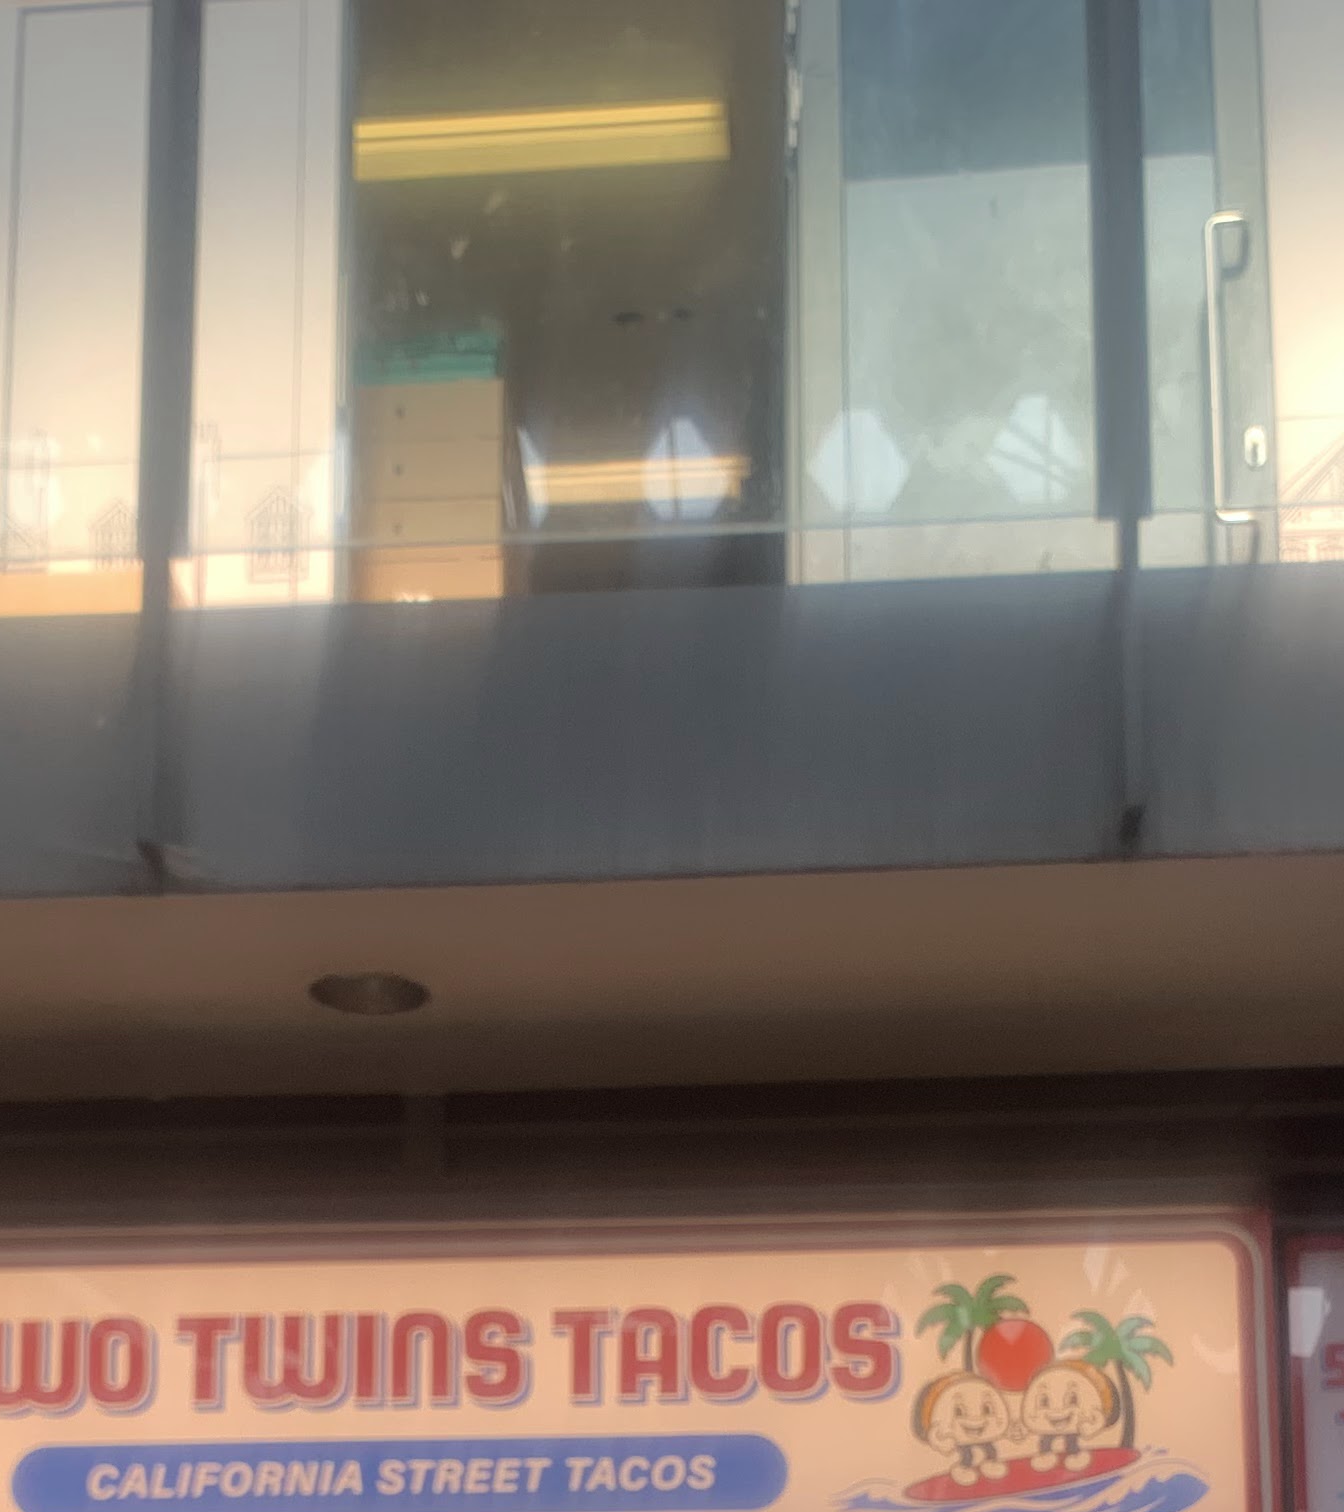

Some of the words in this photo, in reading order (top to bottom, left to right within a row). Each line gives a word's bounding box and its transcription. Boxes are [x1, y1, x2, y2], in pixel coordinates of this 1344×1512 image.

[176, 1307, 534, 1411] TWINS
[552, 1302, 902, 1407] TACOS
[86, 1459, 364, 1501] CALIFORNIA
[375, 1456, 553, 1496] STREET
[567, 1453, 717, 1492] TACOS
